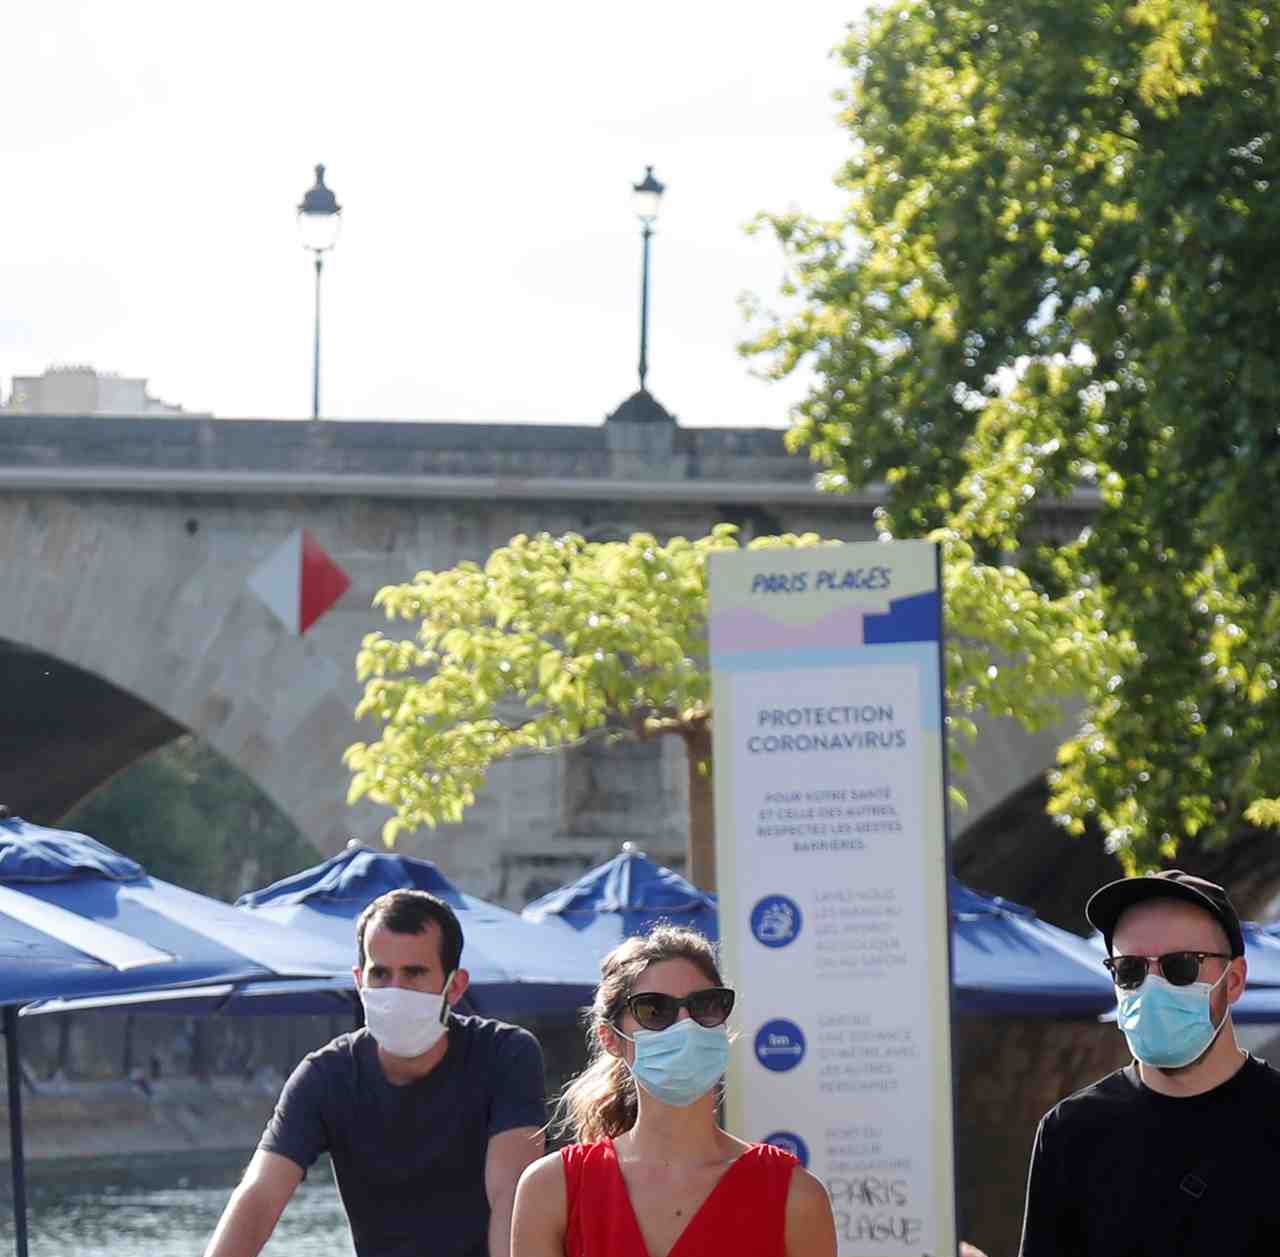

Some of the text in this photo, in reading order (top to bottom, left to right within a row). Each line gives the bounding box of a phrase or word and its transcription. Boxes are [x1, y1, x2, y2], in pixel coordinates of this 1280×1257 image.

[751, 566, 892, 593] PARIS PLAGES
[759, 704, 895, 727] PROTECTION
[747, 728, 908, 753] CORONAVIRUS
[826, 1177, 907, 1207] PARIS
